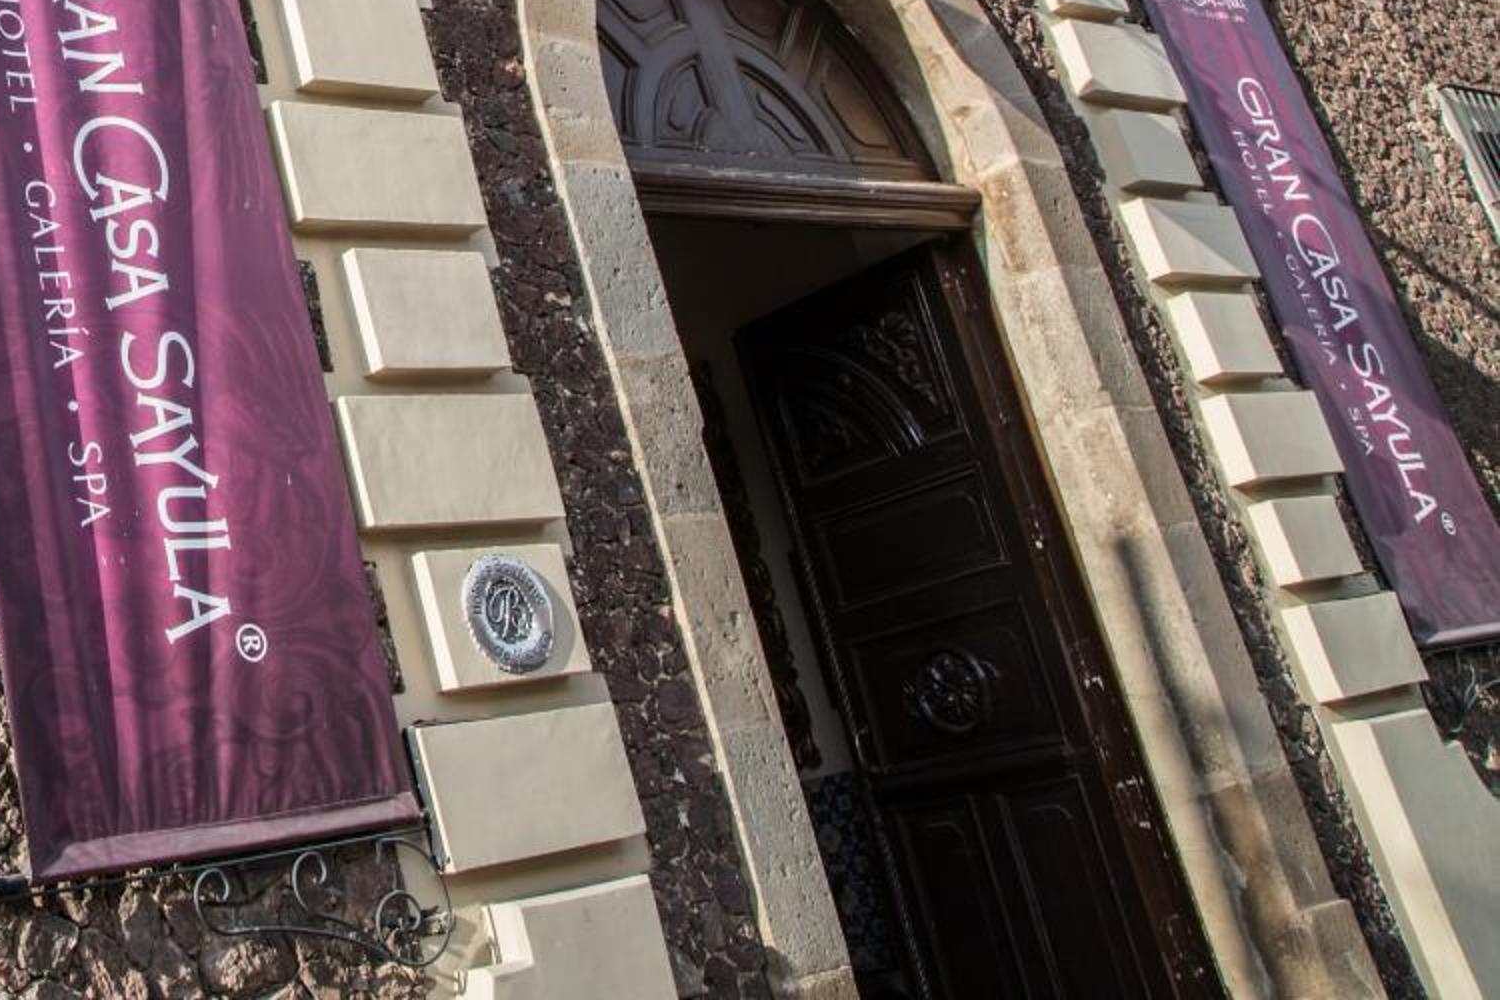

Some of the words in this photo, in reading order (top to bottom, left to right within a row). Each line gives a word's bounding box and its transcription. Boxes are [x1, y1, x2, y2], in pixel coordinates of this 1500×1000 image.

[72, 115, 169, 311] CASA
[1231, 129, 1277, 216] HOTEL
[1348, 407, 1376, 456] SPA
[1237, 76, 1311, 202] GRAN
[1291, 213, 1360, 332] CASA
[24, 180, 90, 370] GALERÍA
[67, 440, 112, 528] SPA
